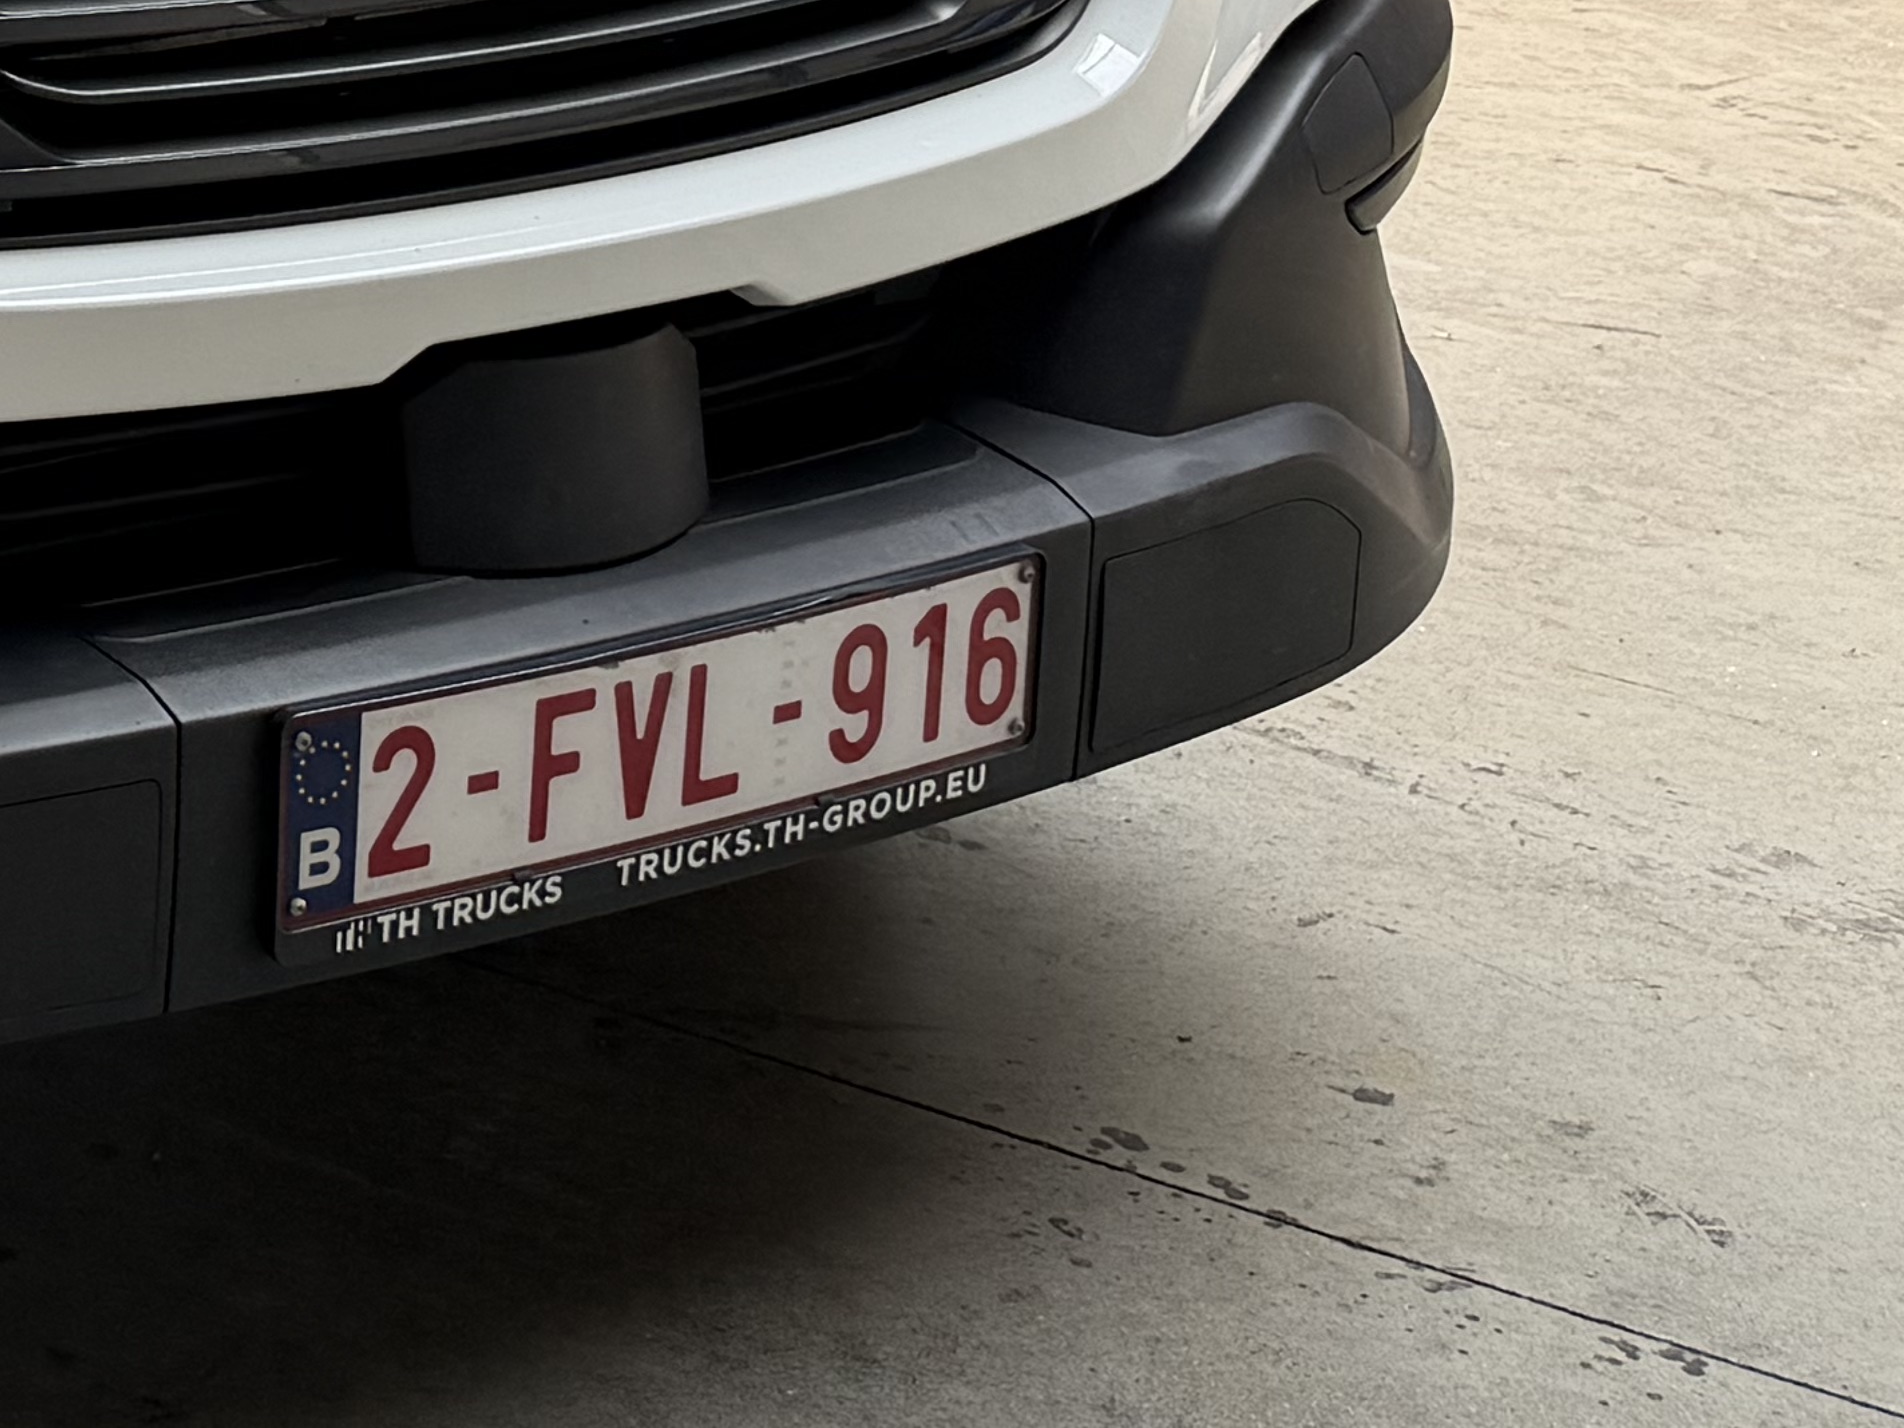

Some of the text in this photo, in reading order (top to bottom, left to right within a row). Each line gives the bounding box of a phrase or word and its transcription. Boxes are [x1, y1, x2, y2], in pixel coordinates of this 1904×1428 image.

[366, 586, 1022, 880] 2-FVL-916
[297, 827, 342, 891] B
[616, 763, 988, 888] TRUCKS.TH-GROUP.EU
[376, 875, 563, 943] TH TRUCKS
